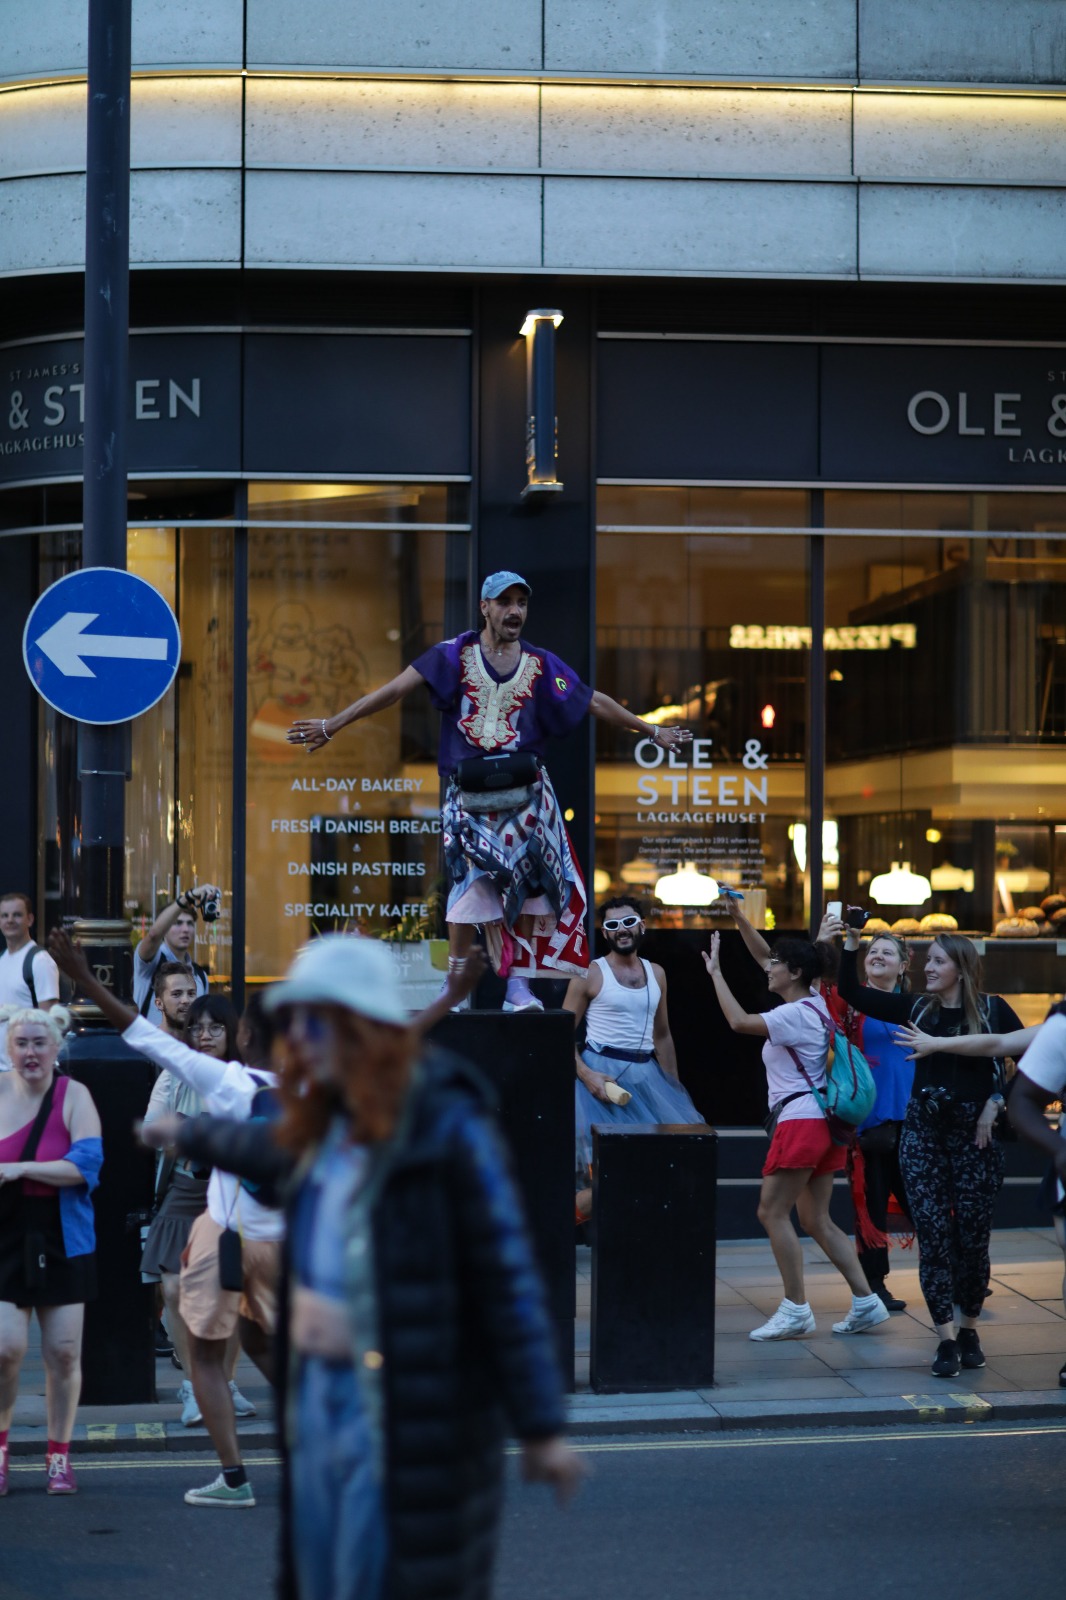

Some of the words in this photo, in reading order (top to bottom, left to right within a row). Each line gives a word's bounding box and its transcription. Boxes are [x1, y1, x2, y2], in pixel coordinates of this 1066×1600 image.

[9, 370, 21, 381] ST
[27, 363, 81, 378] JAMES'S
[8, 390, 30, 431] &
[43, 378, 200, 427] STEN
[907, 390, 1022, 436] OLE
[634, 738, 713, 769] OLE
[742, 738, 769, 770] &
[291, 778, 357, 792] ALL-DAY
[361, 778, 423, 792] BAKERY
[636, 775, 768, 806] STEEN
[637, 812, 767, 824] LAGKAGEHUSET
[271, 820, 321, 833] FRESH
[325, 820, 385, 834] DANISH
[389, 820, 442, 834] BREAD
[288, 861, 348, 875] DANISH
[352, 862, 426, 876] PASTRIES
[284, 903, 375, 917] SPECIALITY
[380, 904, 429, 917] KAFFE
